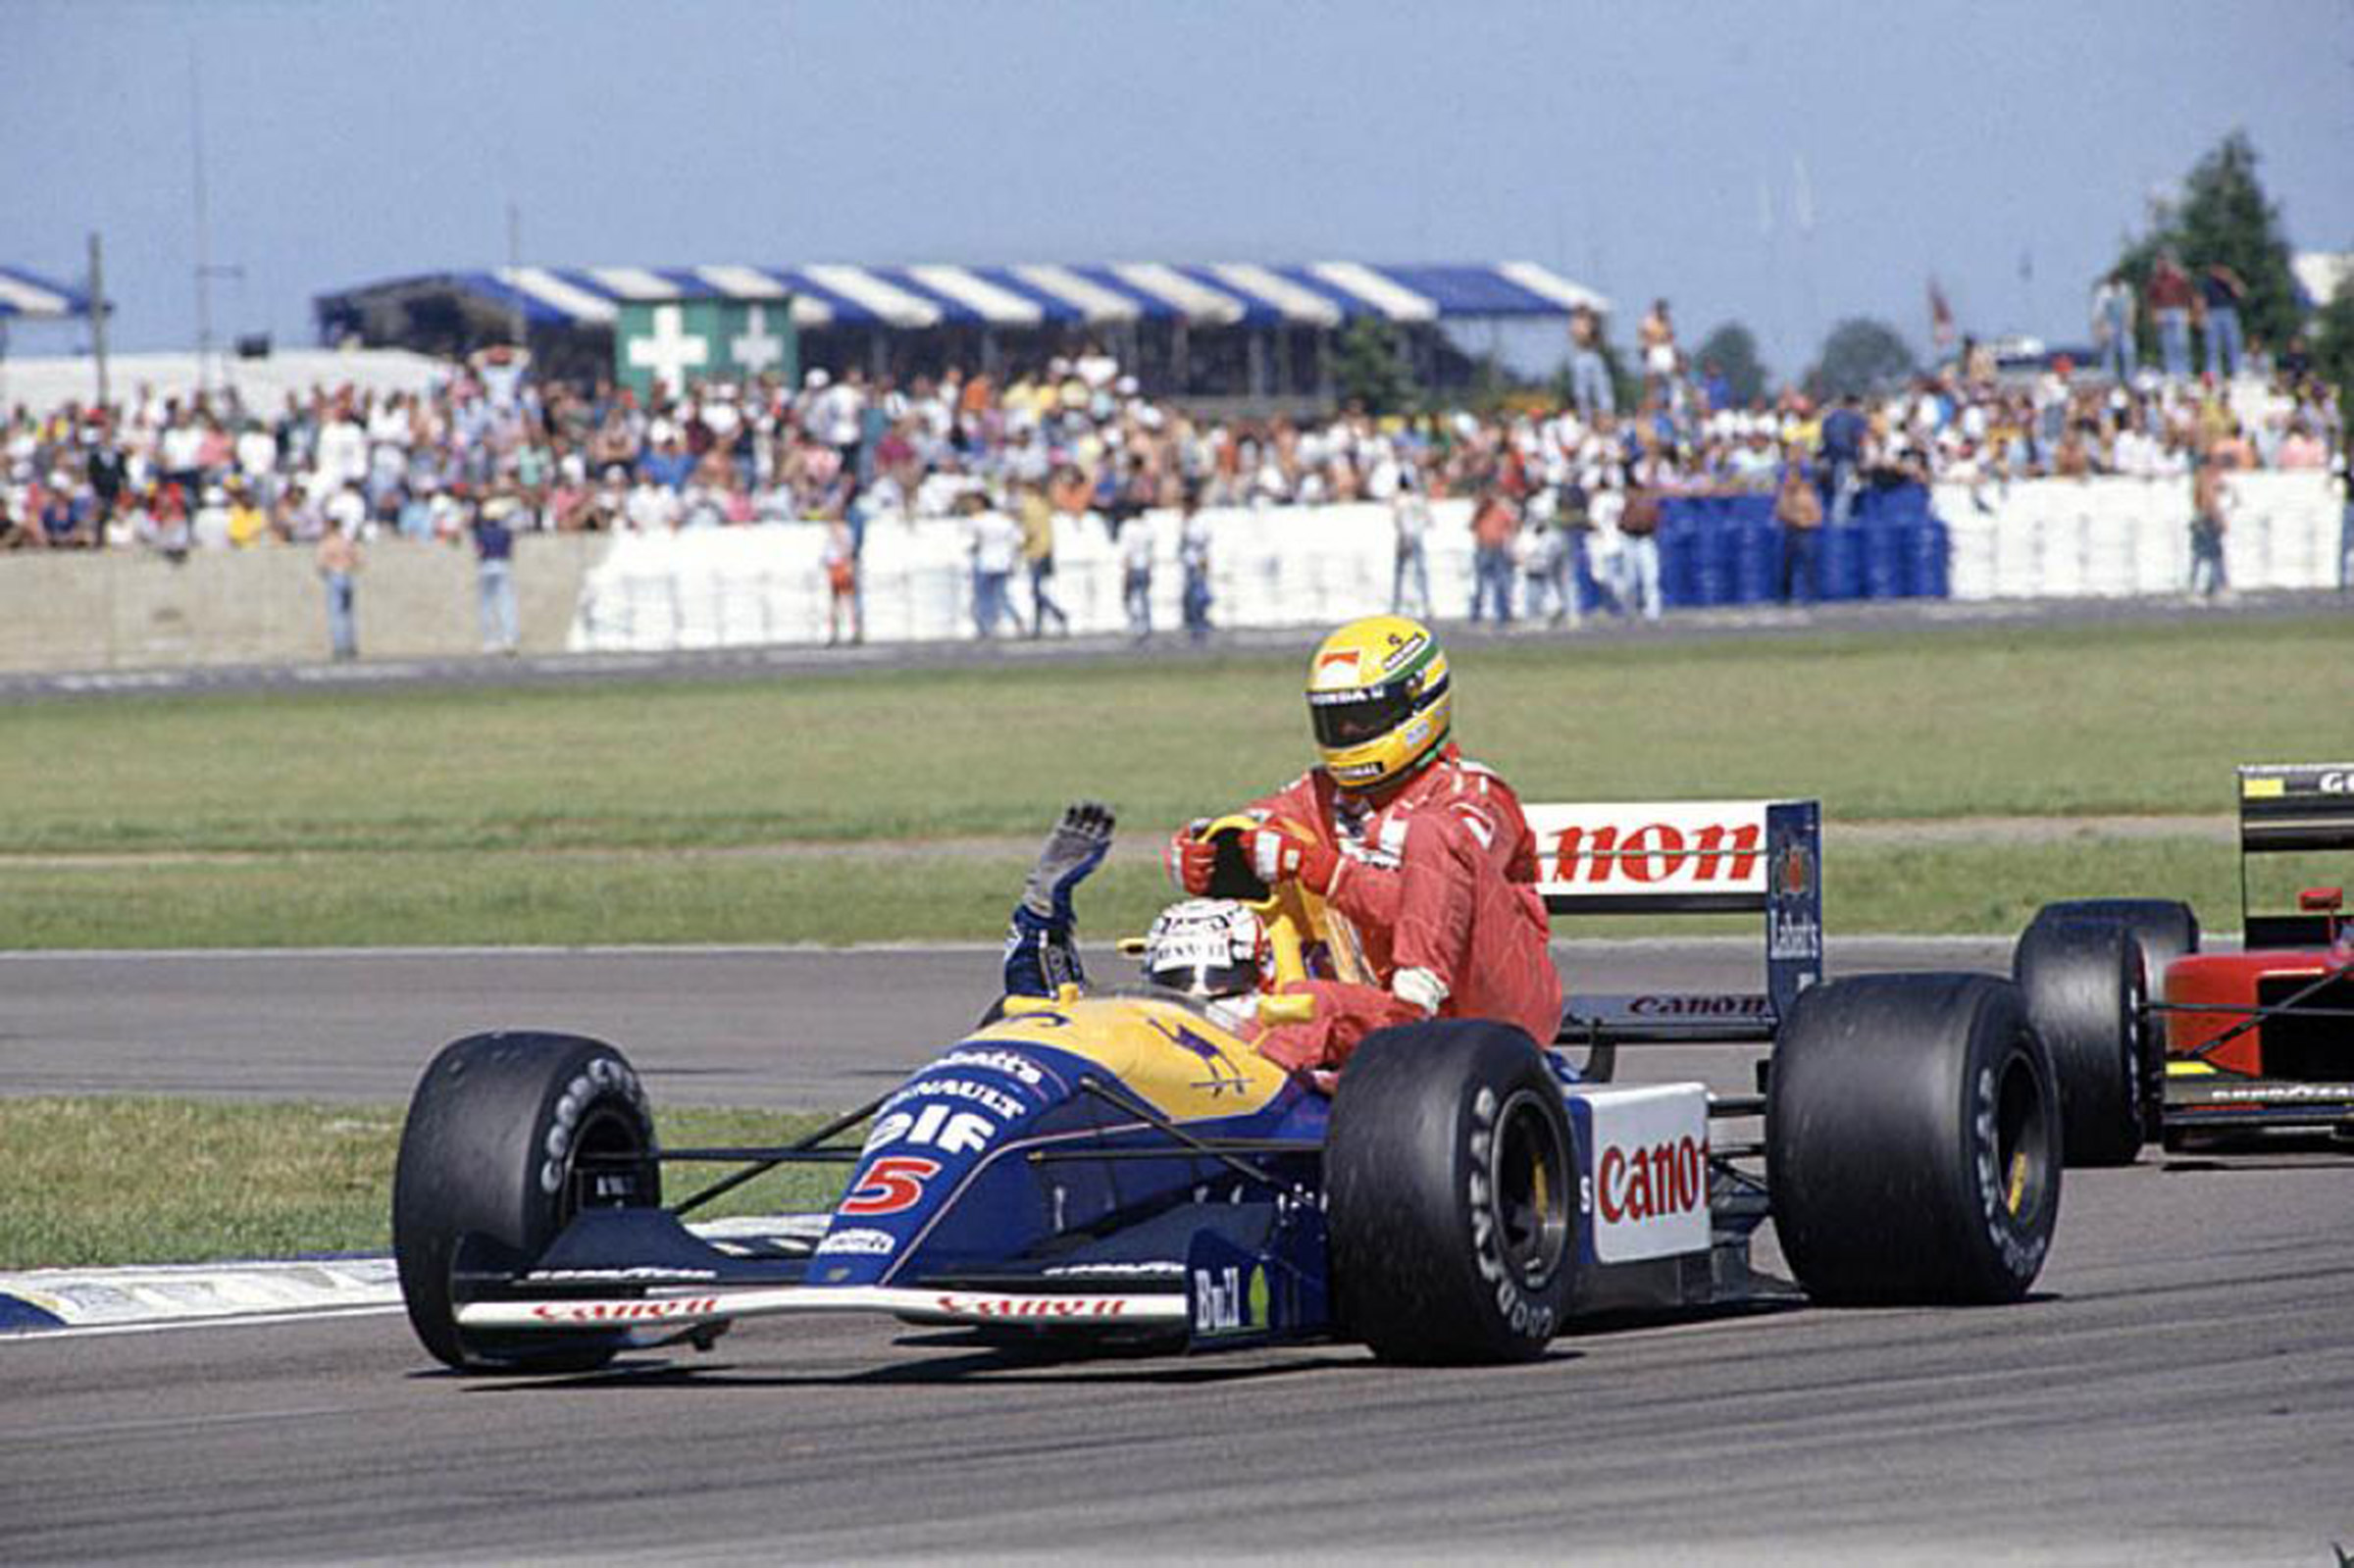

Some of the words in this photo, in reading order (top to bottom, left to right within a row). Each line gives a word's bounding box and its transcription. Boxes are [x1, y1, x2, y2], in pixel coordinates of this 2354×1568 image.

[2319, 772, 2354, 793] G
[1532, 823, 1760, 884] non
[1629, 994, 1768, 1016] Canon
[876, 1080, 1027, 1120] NAULT
[837, 1156, 943, 1216] 5
